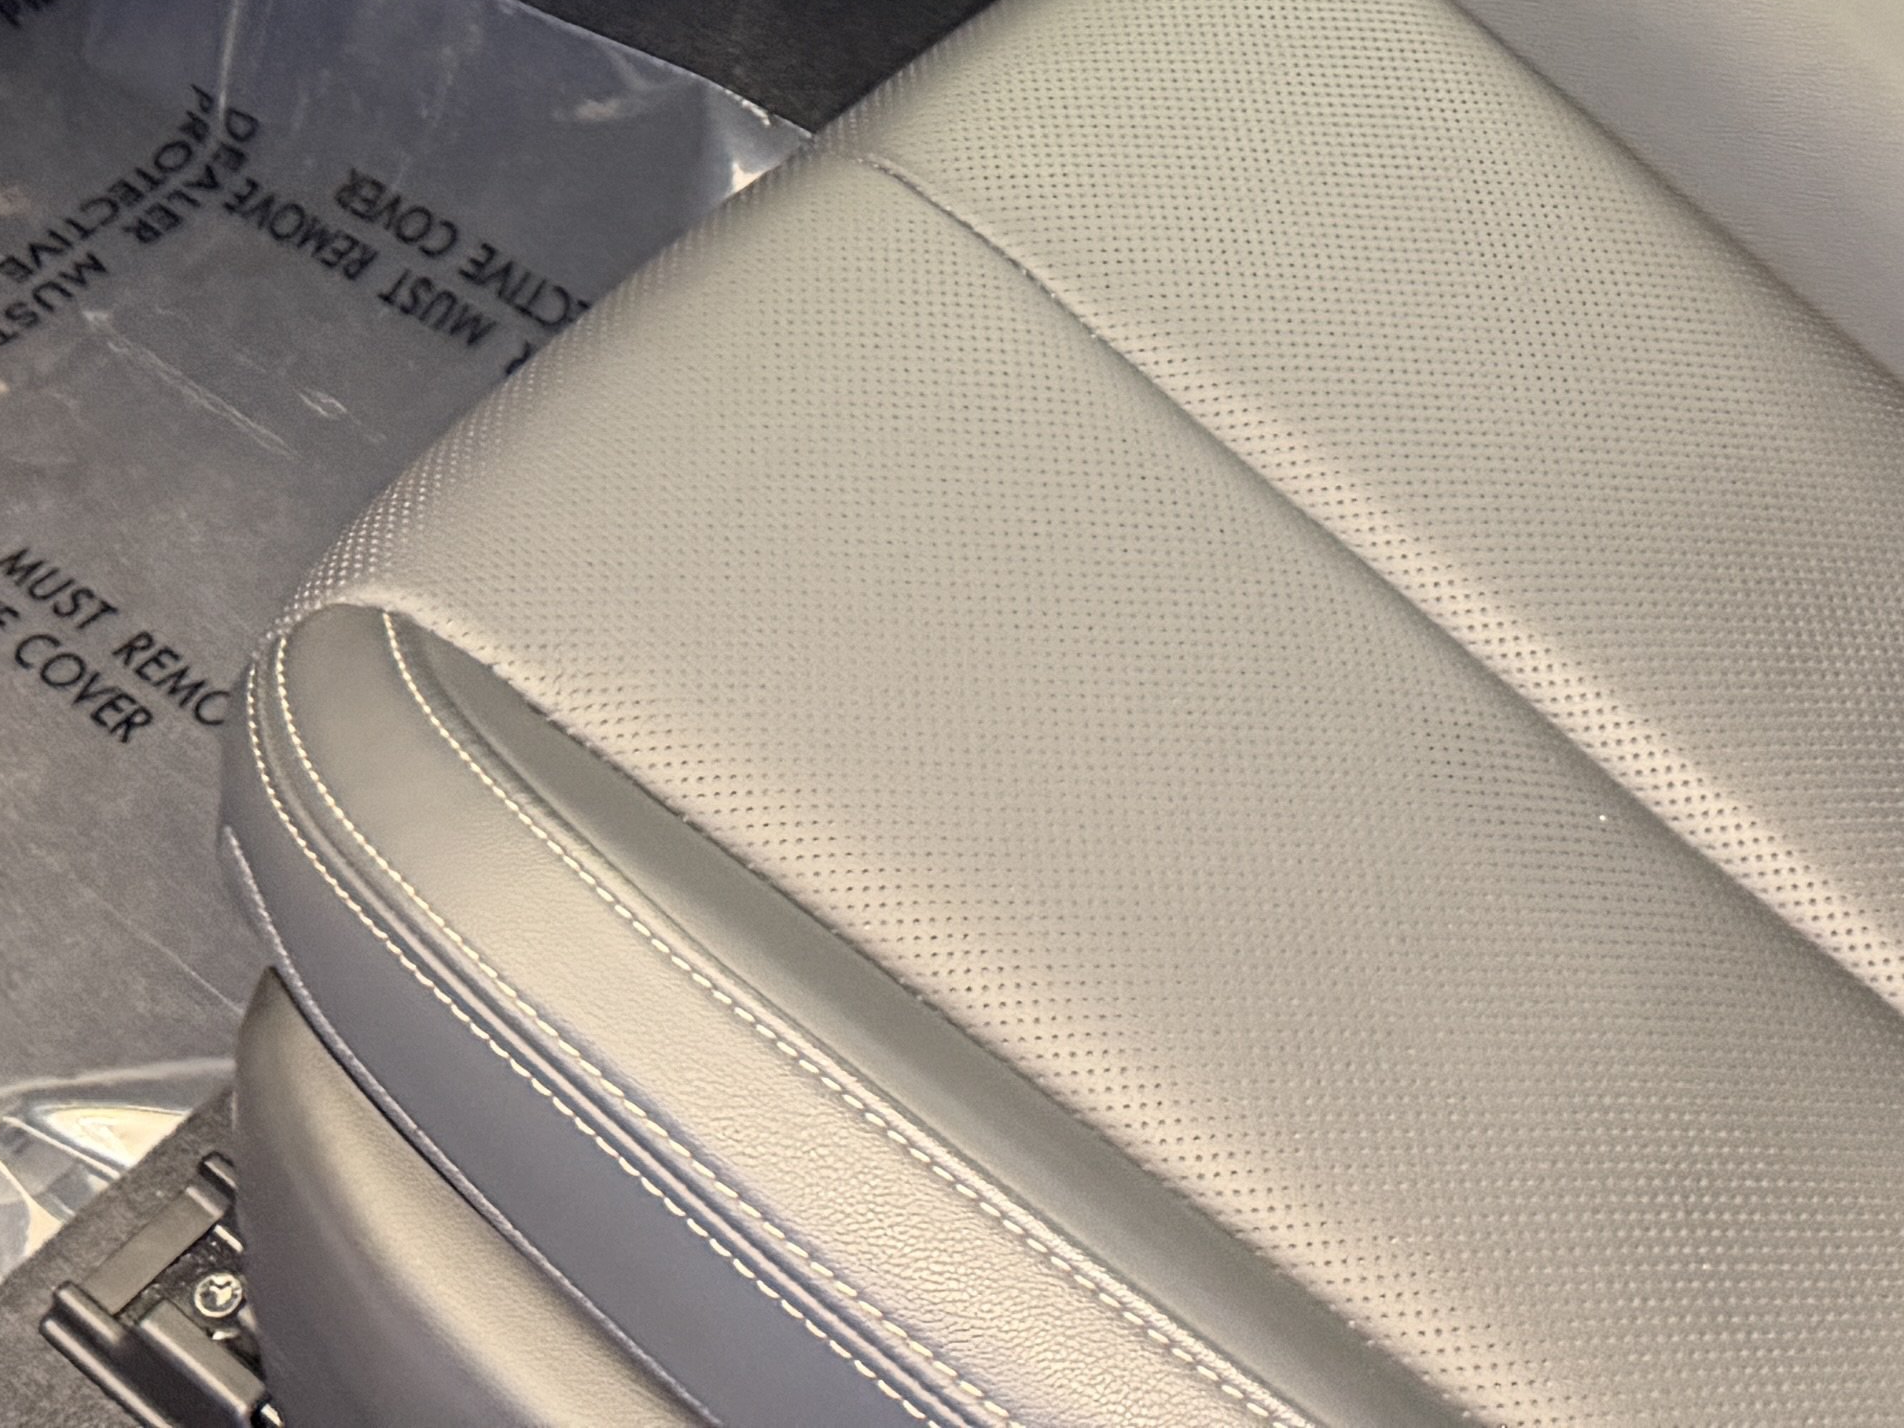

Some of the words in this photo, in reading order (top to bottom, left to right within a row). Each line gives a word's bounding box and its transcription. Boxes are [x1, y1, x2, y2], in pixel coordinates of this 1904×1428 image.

[122, 106, 259, 245] DEALER
[334, 167, 459, 259] COVER
[222, 177, 379, 282] REMOVE
[377, 267, 499, 348] MUST
[12, 632, 154, 744] COVER
